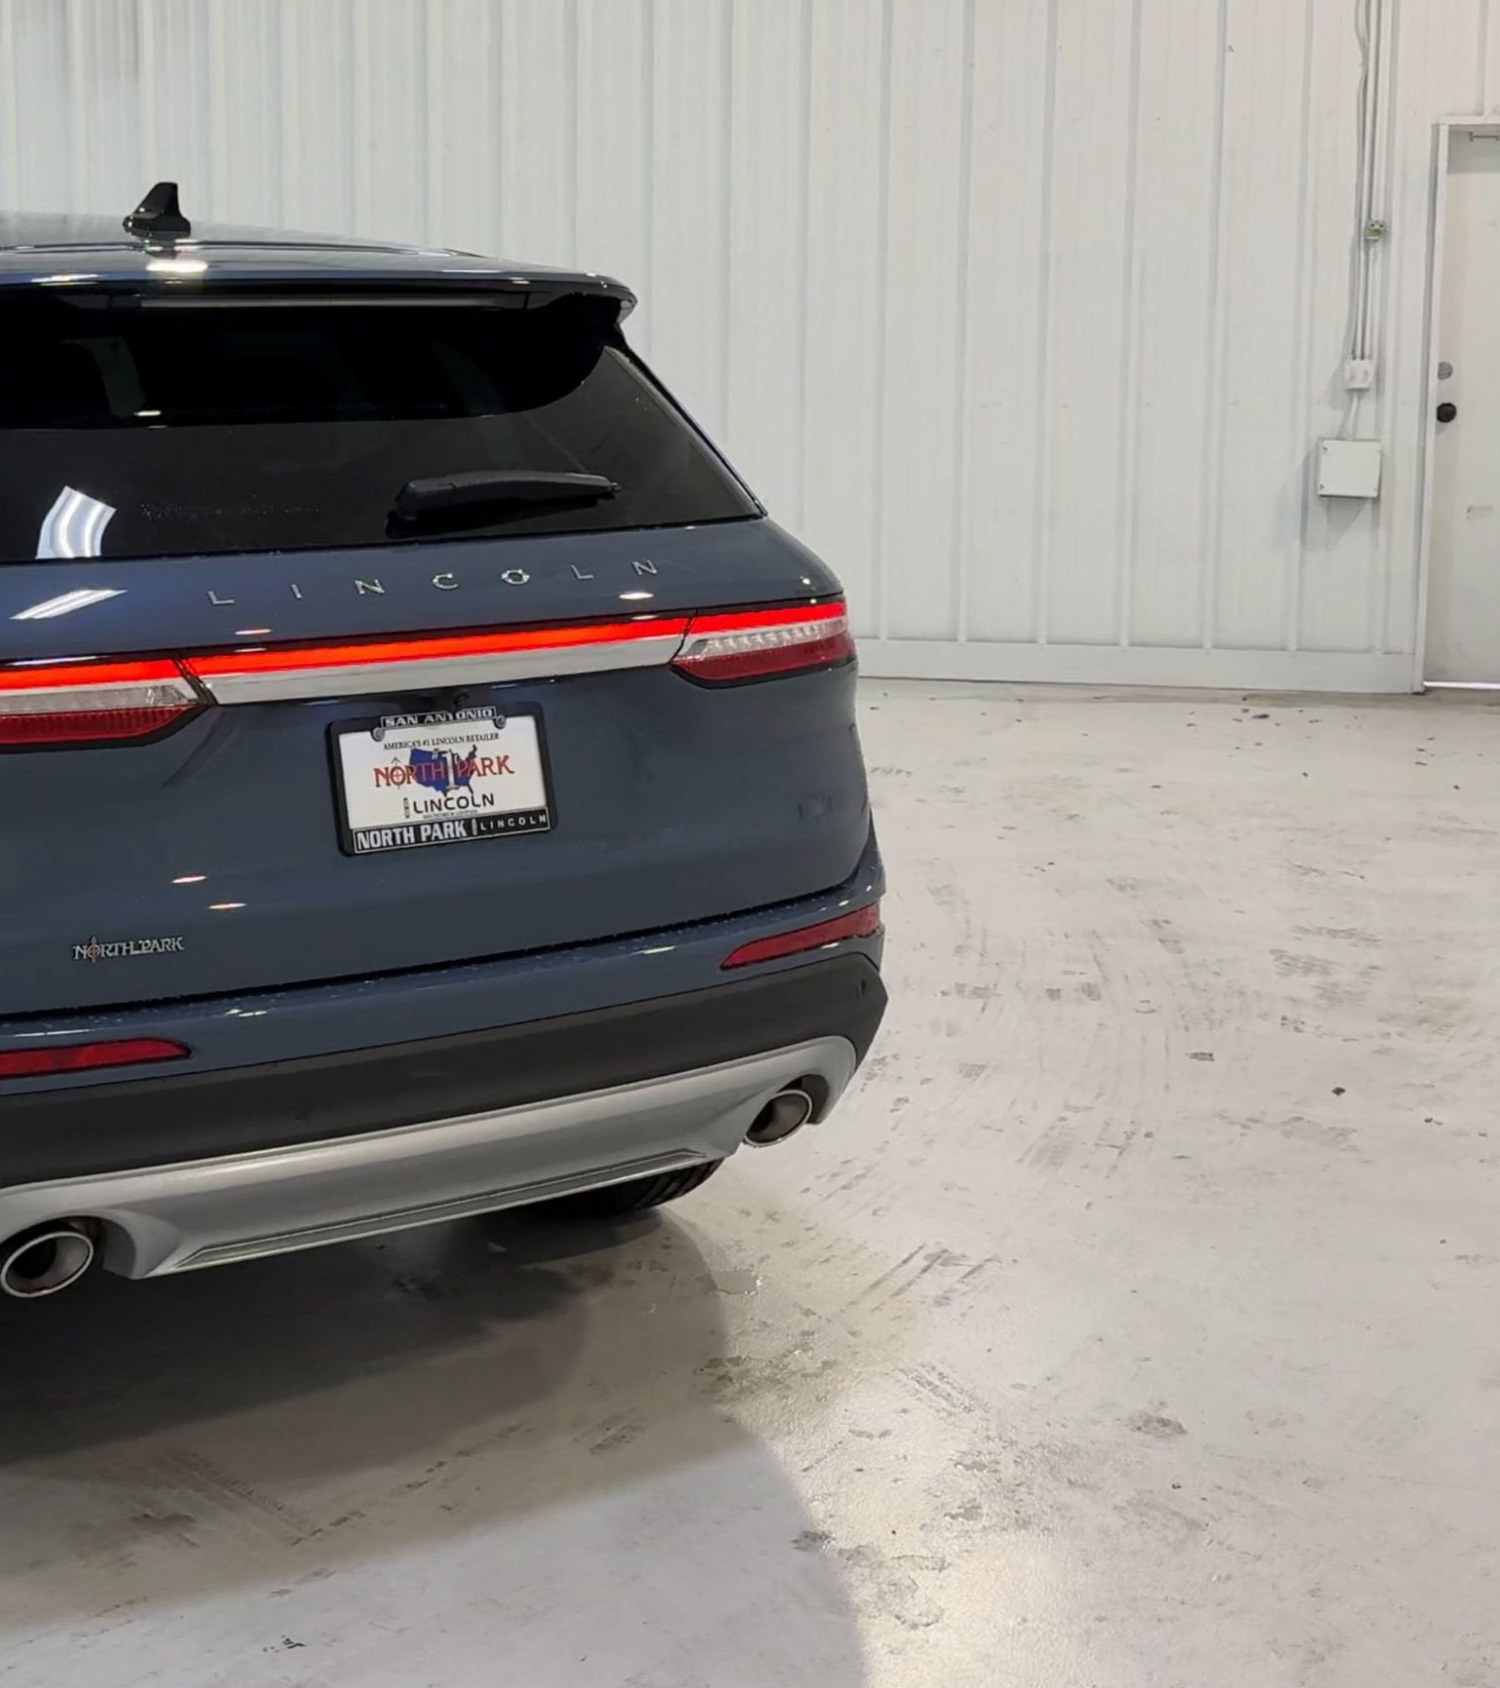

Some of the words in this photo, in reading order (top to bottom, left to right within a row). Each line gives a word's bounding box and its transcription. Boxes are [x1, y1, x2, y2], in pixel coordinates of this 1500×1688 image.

[207, 559, 658, 605] LINCOLN
[385, 716, 419, 728] SAN
[431, 734, 465, 746] LINCOLN
[466, 732, 500, 743] RETAILER
[373, 761, 445, 788] NORTH
[454, 755, 515, 777] PARK
[413, 793, 494, 814] LINCOLN
[357, 826, 416, 850] NORTH
[420, 820, 467, 842] PARK
[480, 814, 546, 831] LINCOLN
